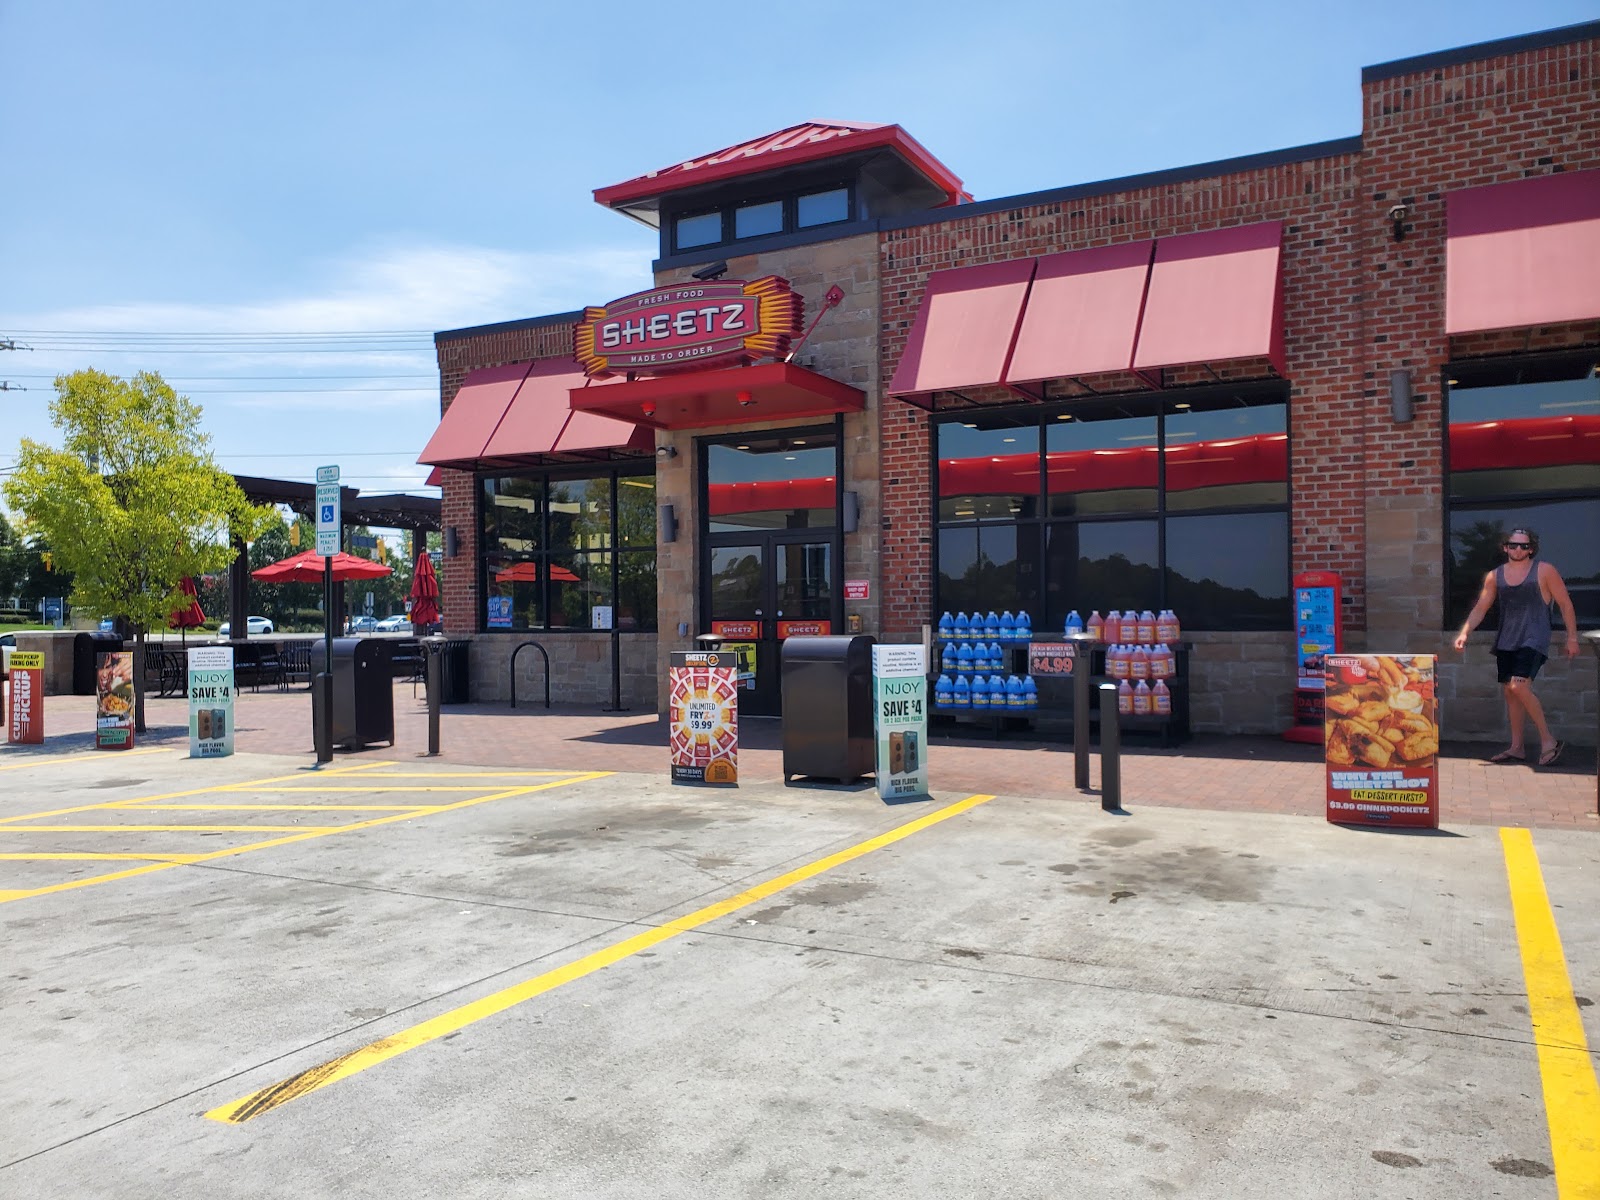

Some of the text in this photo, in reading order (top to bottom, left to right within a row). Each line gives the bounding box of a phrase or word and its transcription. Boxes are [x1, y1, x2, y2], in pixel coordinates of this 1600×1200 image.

[638, 289, 704, 307] FRESH FOOD
[602, 303, 745, 348] SHEETZ
[630, 345, 713, 363] MADE TO ORDER
[318, 487, 339, 495] RESERVED
[318, 496, 338, 504] PARKING
[1033, 657, 1073, 673] $4.99
[194, 673, 228, 683] NJOY
[192, 686, 230, 699] SAVE $4
[885, 682, 920, 695] NJOY
[21, 670, 31, 722] PICKUP
[13, 670, 21, 740] CURBSIDE
[689, 702, 716, 710] UNLIMITED
[883, 700, 909, 717] SAVE
[911, 699, 922, 715] $4
[1331, 771, 1403, 780] WHY THE
[1331, 778, 1430, 789] SHEETZ NOT
[1353, 791, 1424, 802] EAT DESSERT FIRST?
[1329, 801, 1430, 814] $3.99 CINNAPOCKETZ
